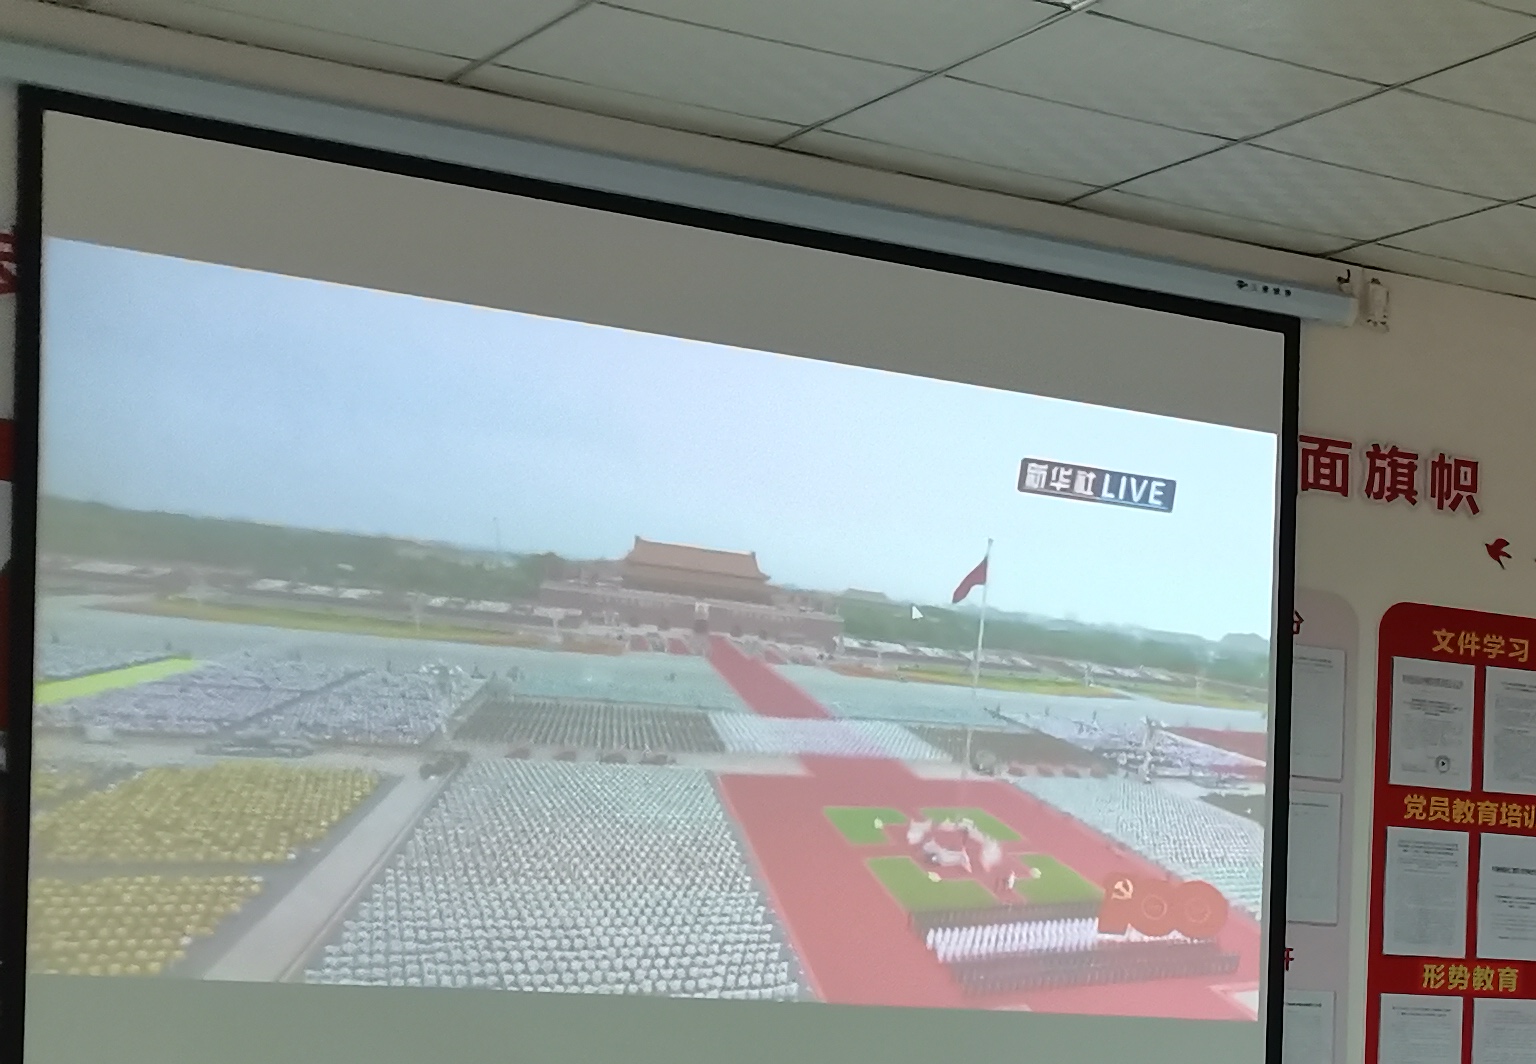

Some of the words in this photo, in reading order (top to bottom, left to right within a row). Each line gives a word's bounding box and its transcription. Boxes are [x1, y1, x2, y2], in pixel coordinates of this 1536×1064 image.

[1101, 472, 1167, 506] LIVE
[1299, 435, 1480, 516] 面旗帜
[1431, 628, 1529, 663] 文件学习
[1423, 964, 1519, 992] 形势教育
